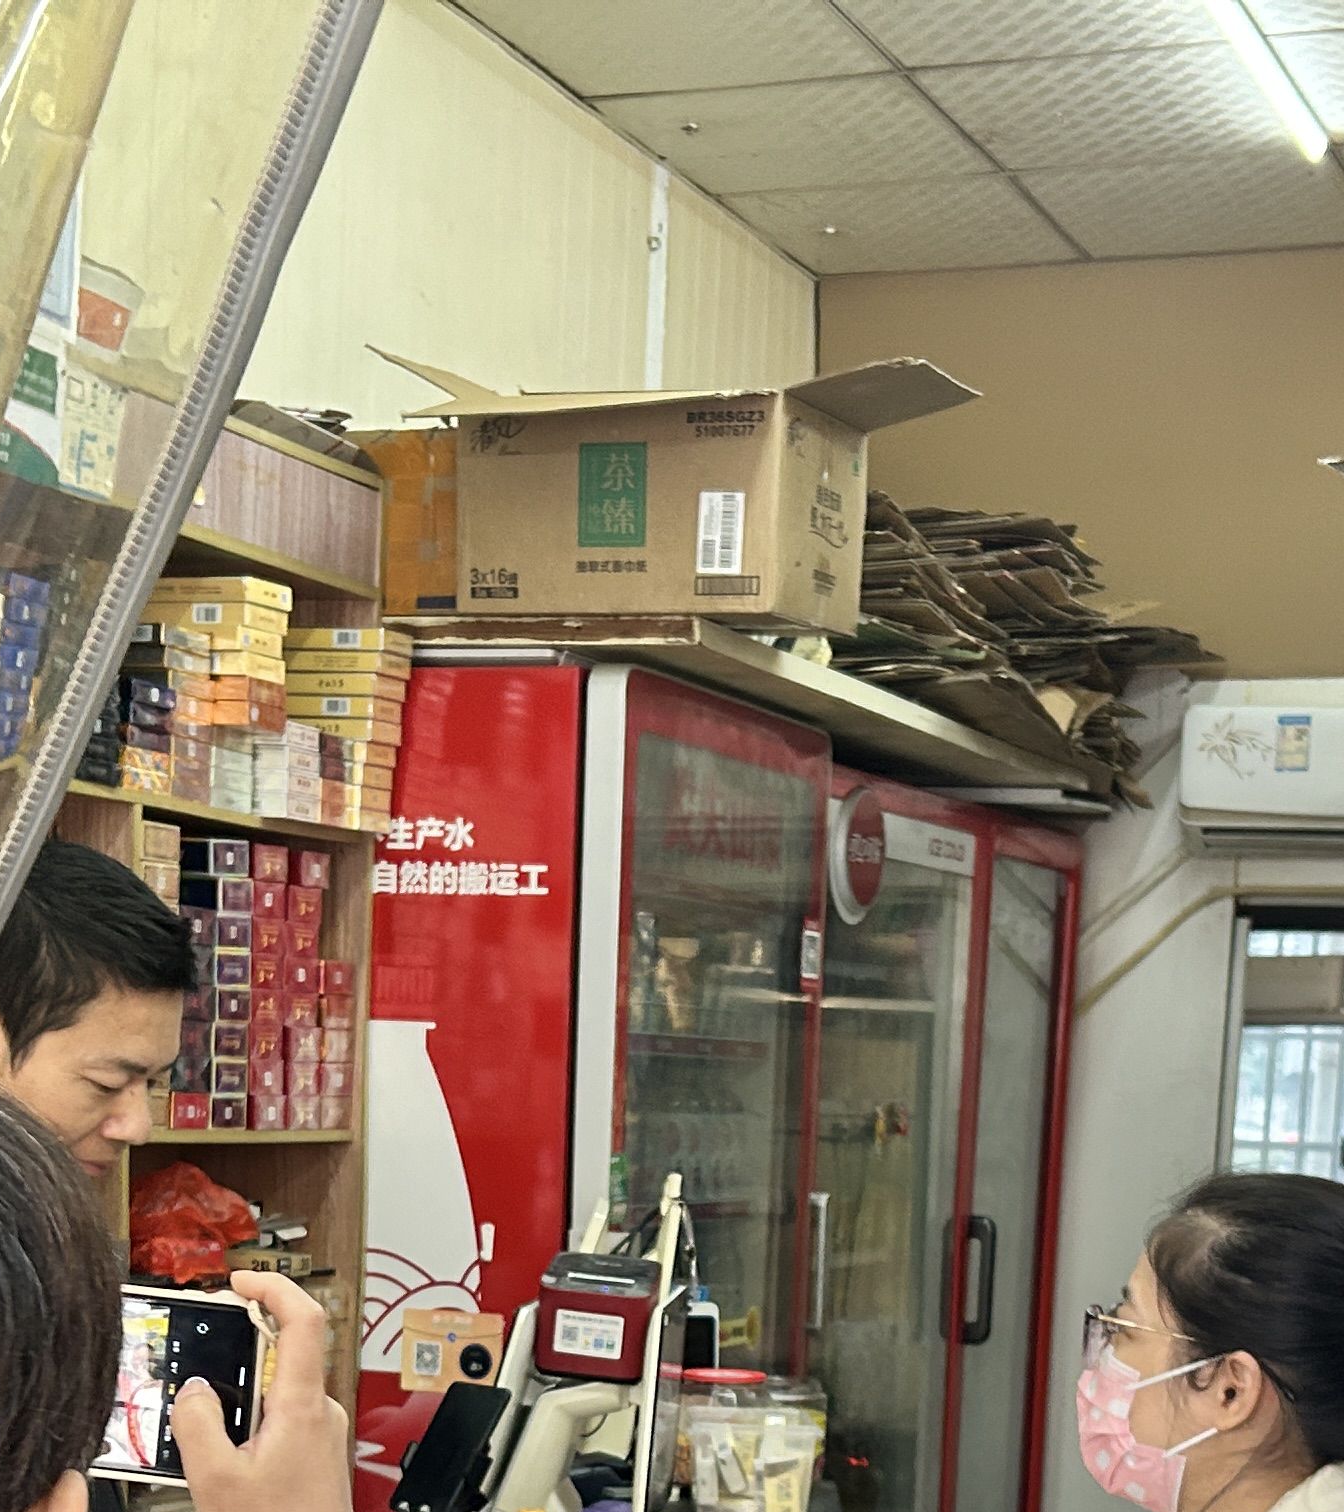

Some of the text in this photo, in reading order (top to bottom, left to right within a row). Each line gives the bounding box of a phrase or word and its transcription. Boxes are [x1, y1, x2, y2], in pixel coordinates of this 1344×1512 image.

[377, 816, 475, 851] 生产水
[372, 860, 549, 895] 自然的搬运工
